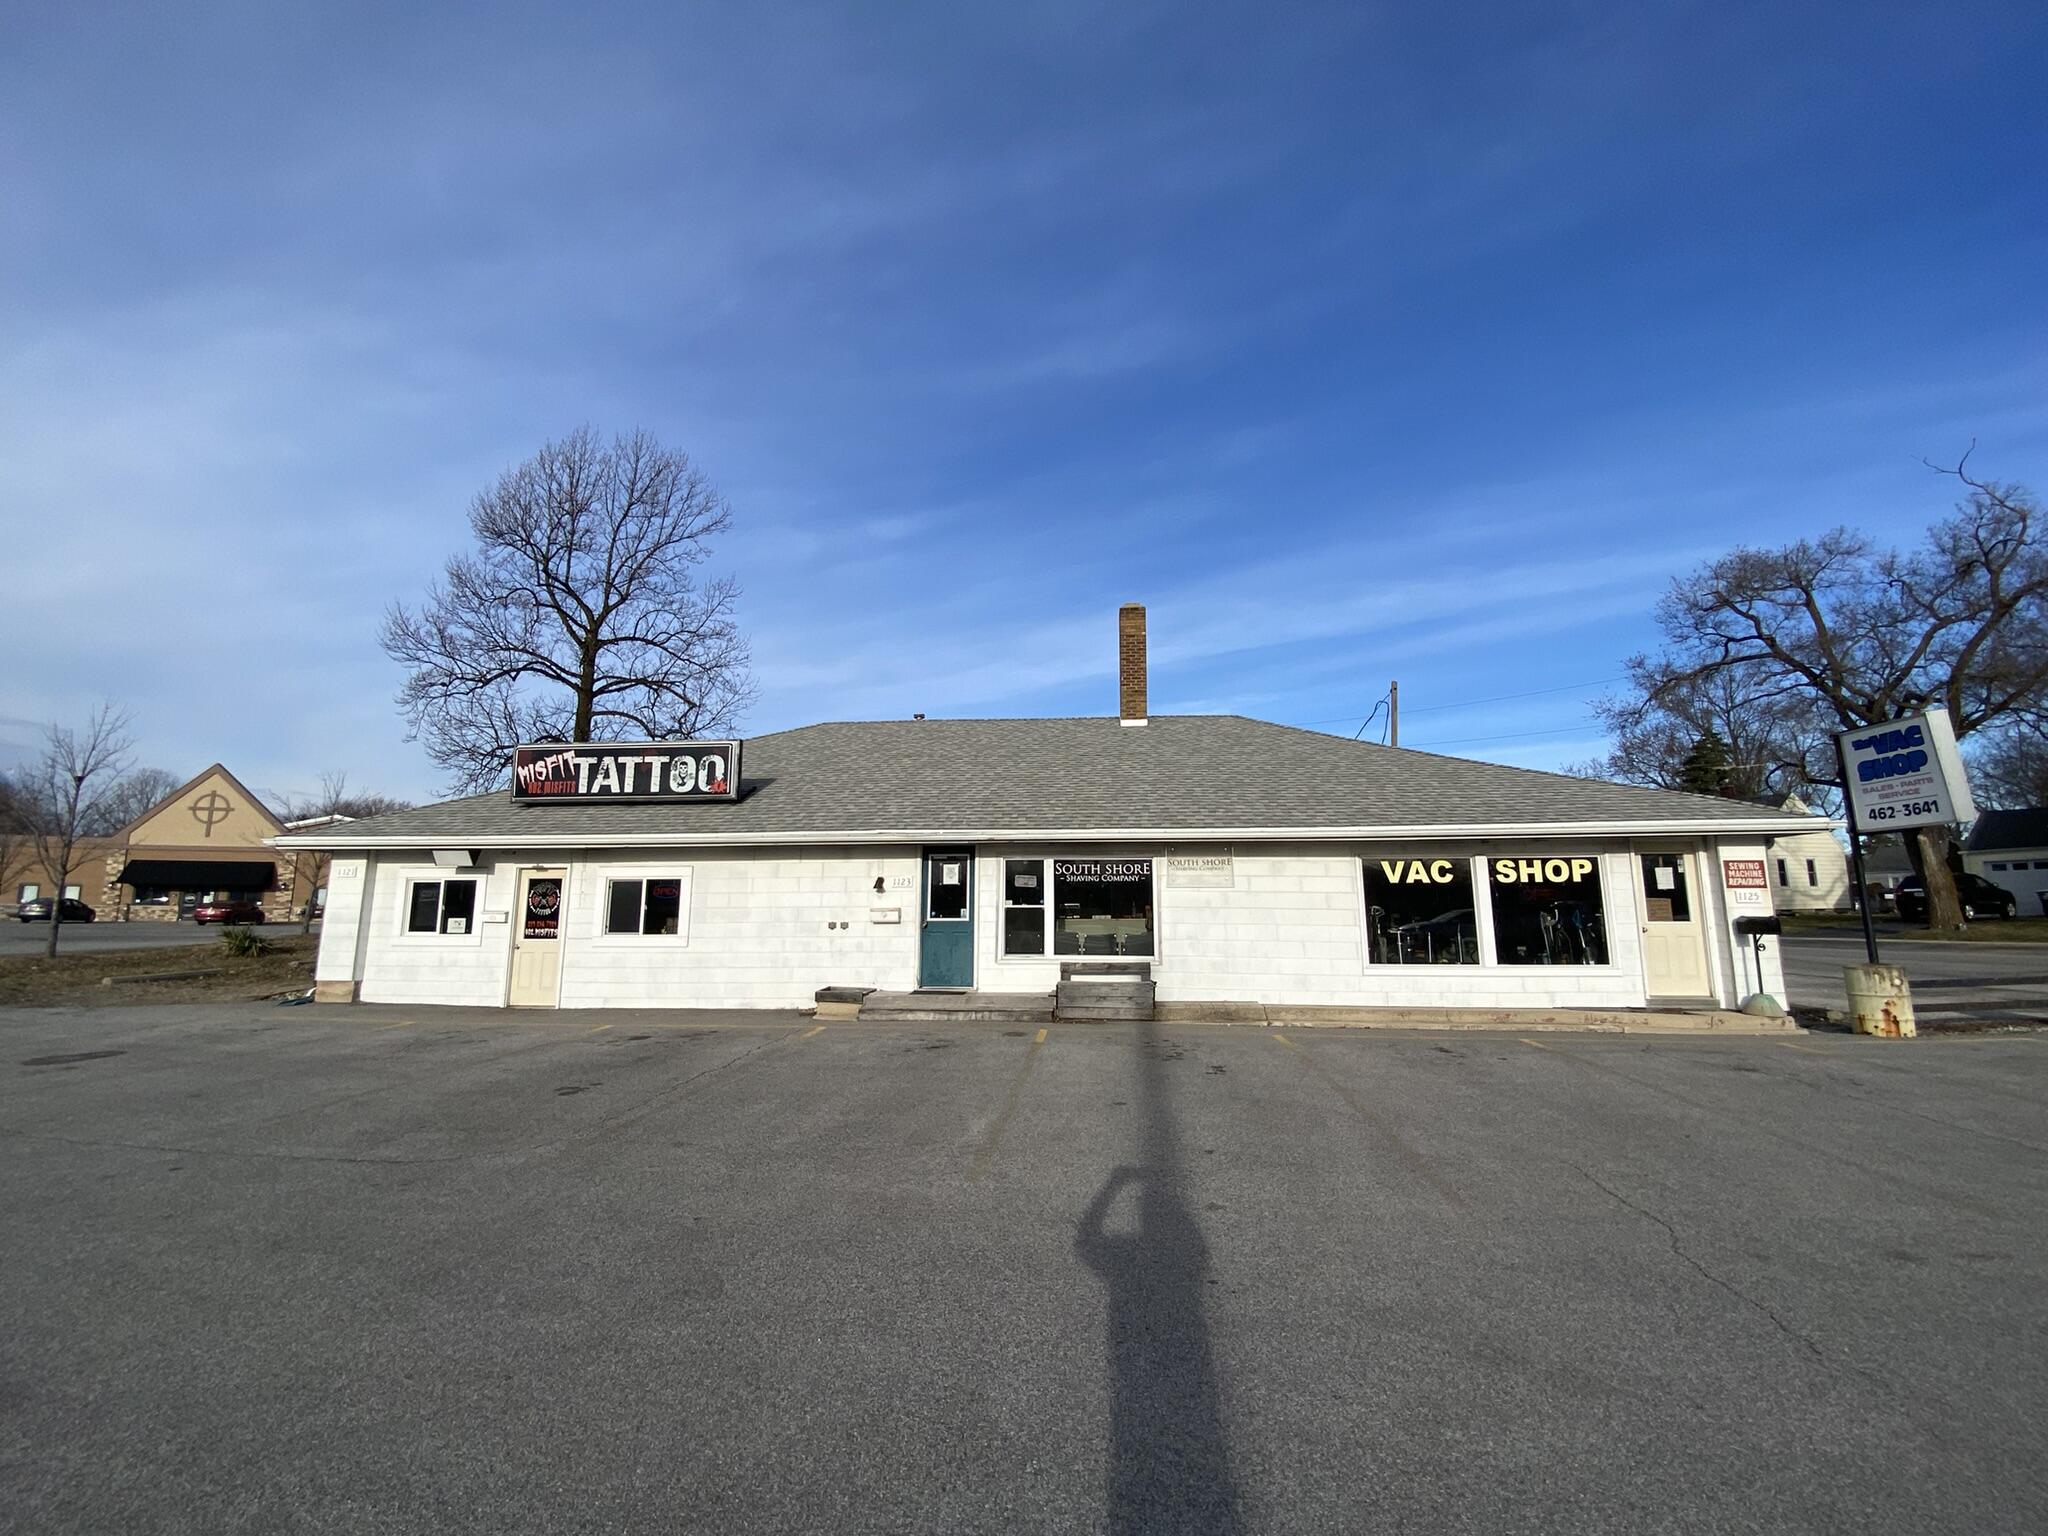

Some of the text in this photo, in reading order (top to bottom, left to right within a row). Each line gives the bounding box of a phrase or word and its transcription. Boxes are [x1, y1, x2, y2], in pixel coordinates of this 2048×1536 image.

[1872, 725, 1925, 754] VAC
[517, 750, 727, 794] MISFIT TATTOO
[1857, 749, 1928, 782] SHOP
[1862, 776, 1934, 794] SALES PARTS
[1878, 787, 1921, 800] SERVICE
[1869, 800, 1940, 820] 462-3641
[1055, 862, 1151, 875] SOUTH SHORE
[1168, 858, 1233, 867] SOUTH SHORE
[1728, 862, 1760, 870] SEWING
[1380, 859, 1454, 884] VAC
[1495, 859, 1593, 883] SHOP
[1728, 869, 1763, 878] MACHINE
[892, 877, 912, 886] 1123
[1066, 874, 1140, 882] SHAVING COMPANY
[1728, 877, 1765, 886] REPAIRING
[1738, 892, 1761, 901] 1125
